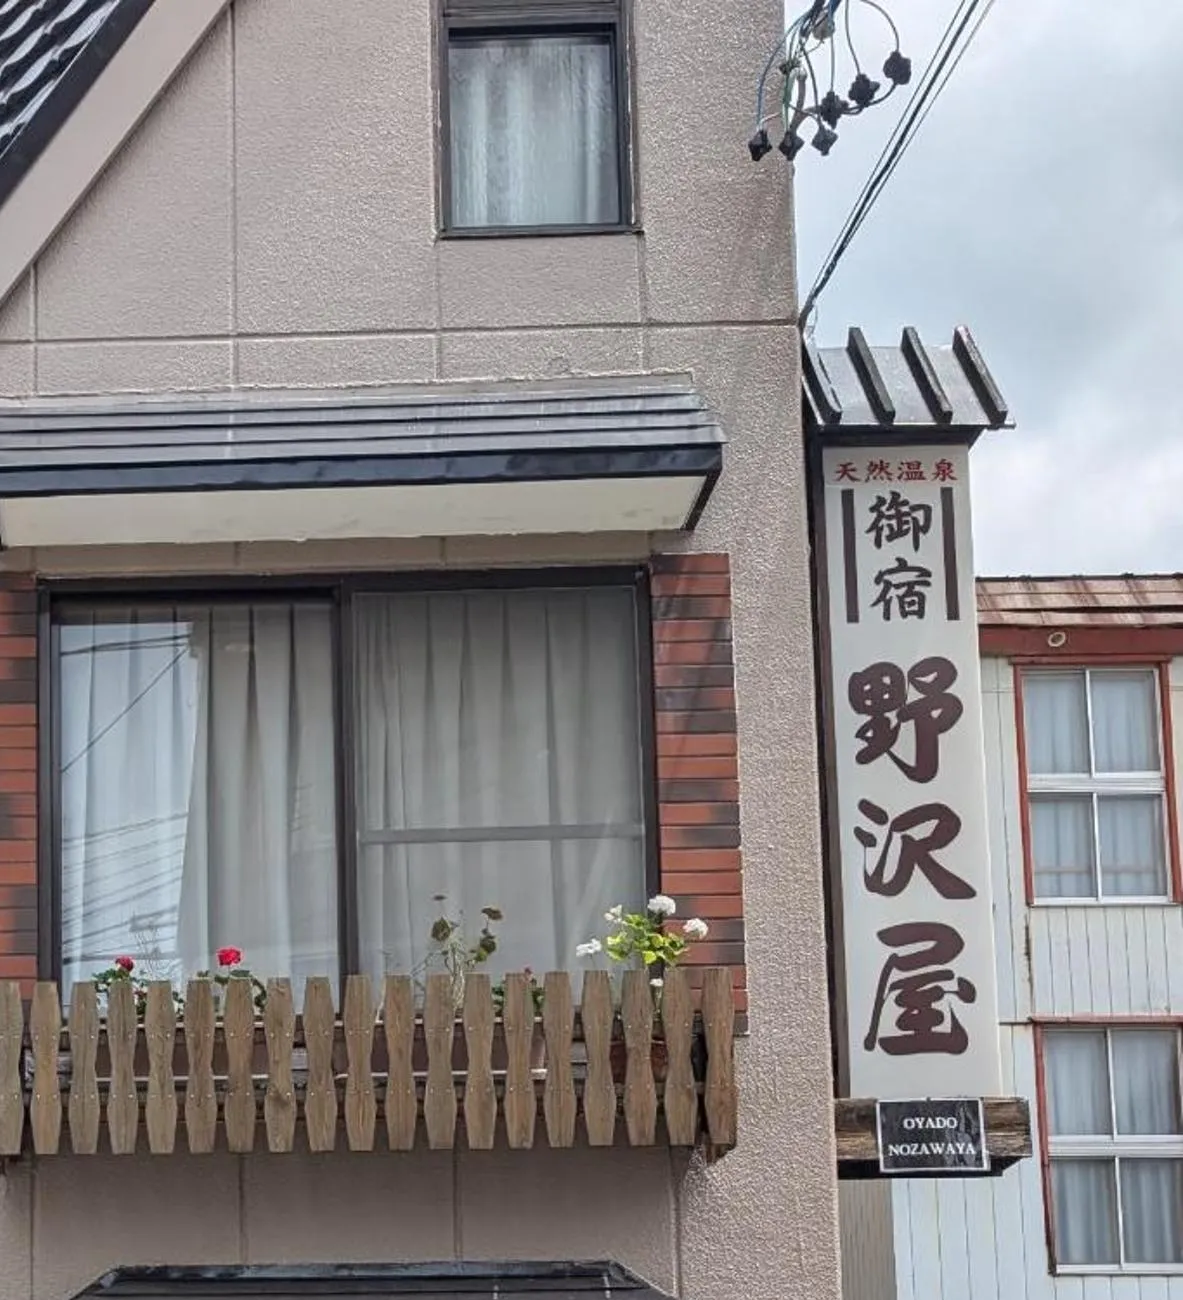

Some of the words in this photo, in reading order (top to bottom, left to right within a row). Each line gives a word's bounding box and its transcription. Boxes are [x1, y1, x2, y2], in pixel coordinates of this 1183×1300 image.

[834, 458, 959, 483] 天然温泉
[865, 490, 933, 622] 御宿
[848, 656, 977, 1056] 野沢屋
[902, 1117, 957, 1130] OYADO
[888, 1142, 976, 1157] NOZAWAYA
